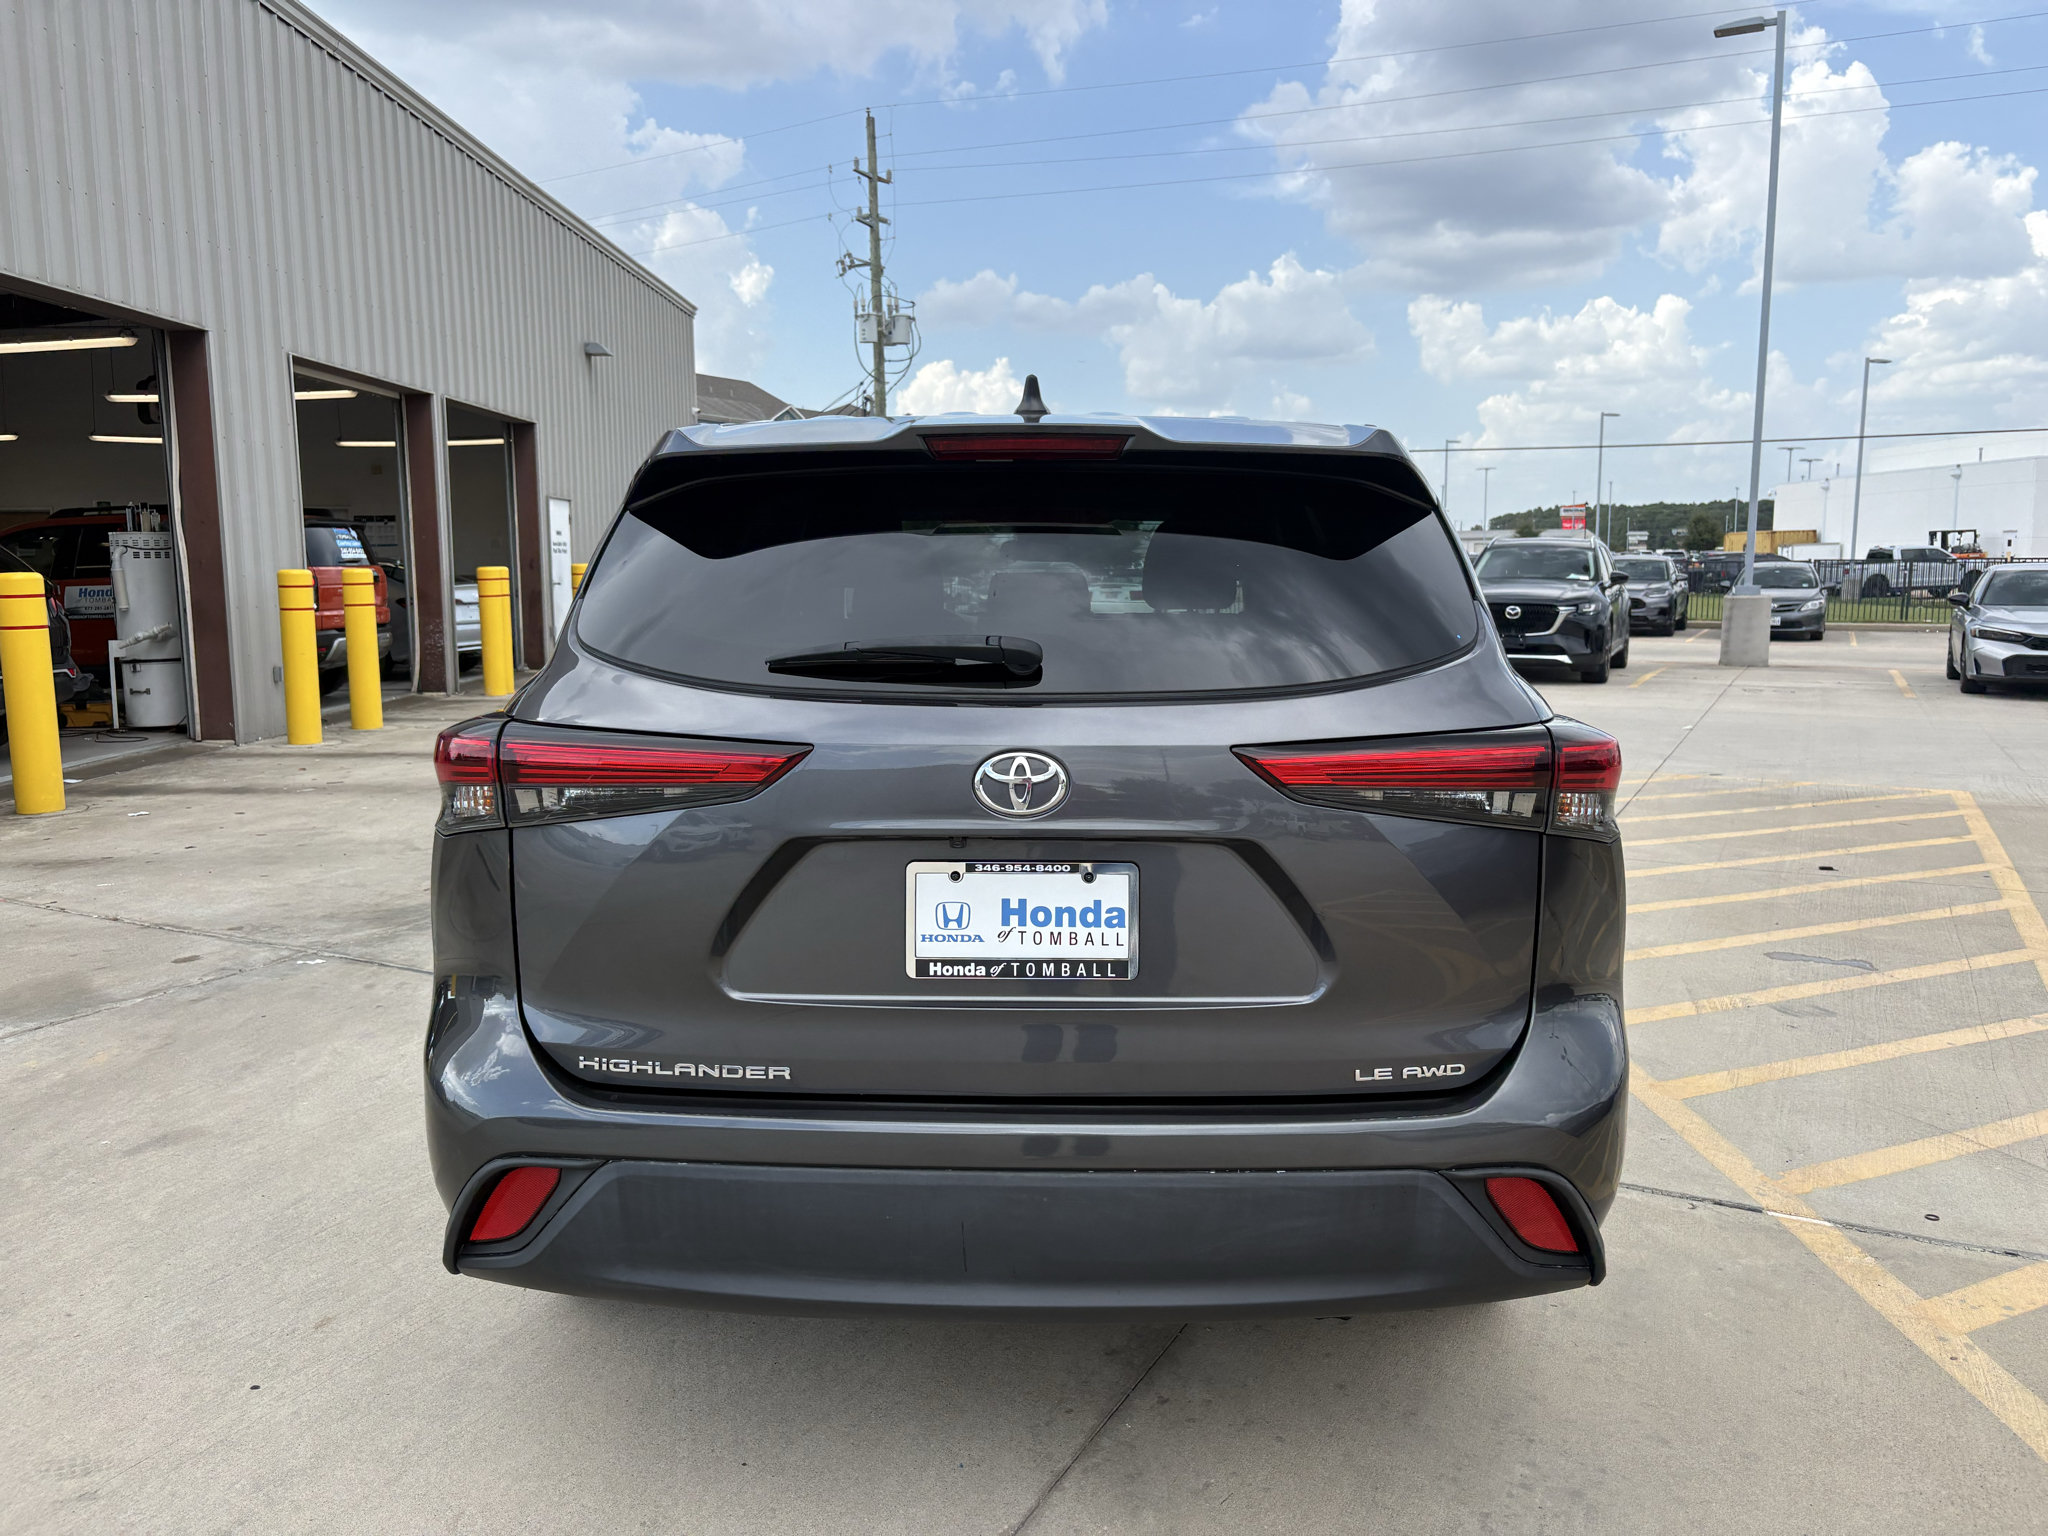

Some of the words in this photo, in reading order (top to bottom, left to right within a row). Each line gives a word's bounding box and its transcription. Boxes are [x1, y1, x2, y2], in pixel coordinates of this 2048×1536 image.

[78, 587, 113, 598] Hond
[974, 864, 1071, 873] 346-954-8400
[1000, 898, 1126, 929] Honda
[920, 933, 985, 943] HONDA
[997, 927, 1016, 943] of
[1018, 930, 1125, 947] TOMBALL
[929, 962, 986, 976] Honda
[989, 962, 1007, 977] of
[1011, 963, 1116, 977] TOMBALL
[578, 1055, 792, 1080] HIGHLANDER
[1355, 1067, 1393, 1082] LE
[1402, 1063, 1466, 1079] AWD
